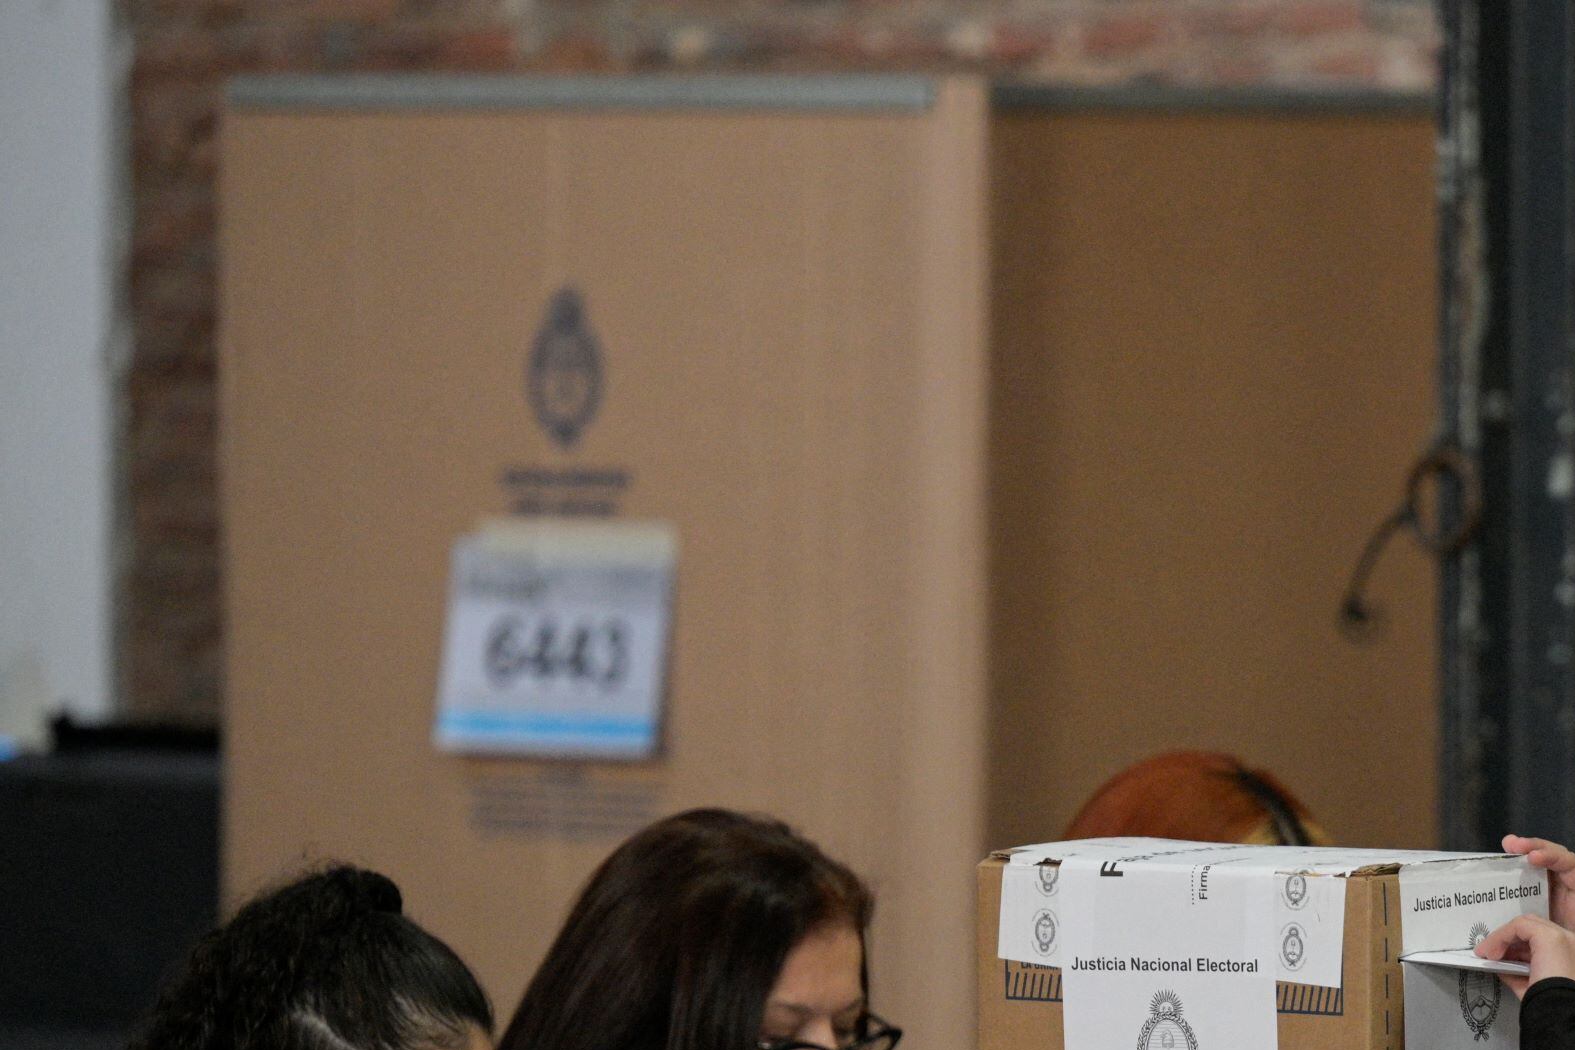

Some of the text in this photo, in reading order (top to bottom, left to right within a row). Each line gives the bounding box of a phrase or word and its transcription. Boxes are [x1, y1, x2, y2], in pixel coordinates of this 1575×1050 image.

[1198, 864, 1212, 900] Firma
[1413, 882, 1542, 912] Justicia Nacional Electoral
[1071, 956, 1127, 972] Justicia
[1130, 957, 1192, 973] Nacional
[1196, 958, 1259, 973] Electoral
